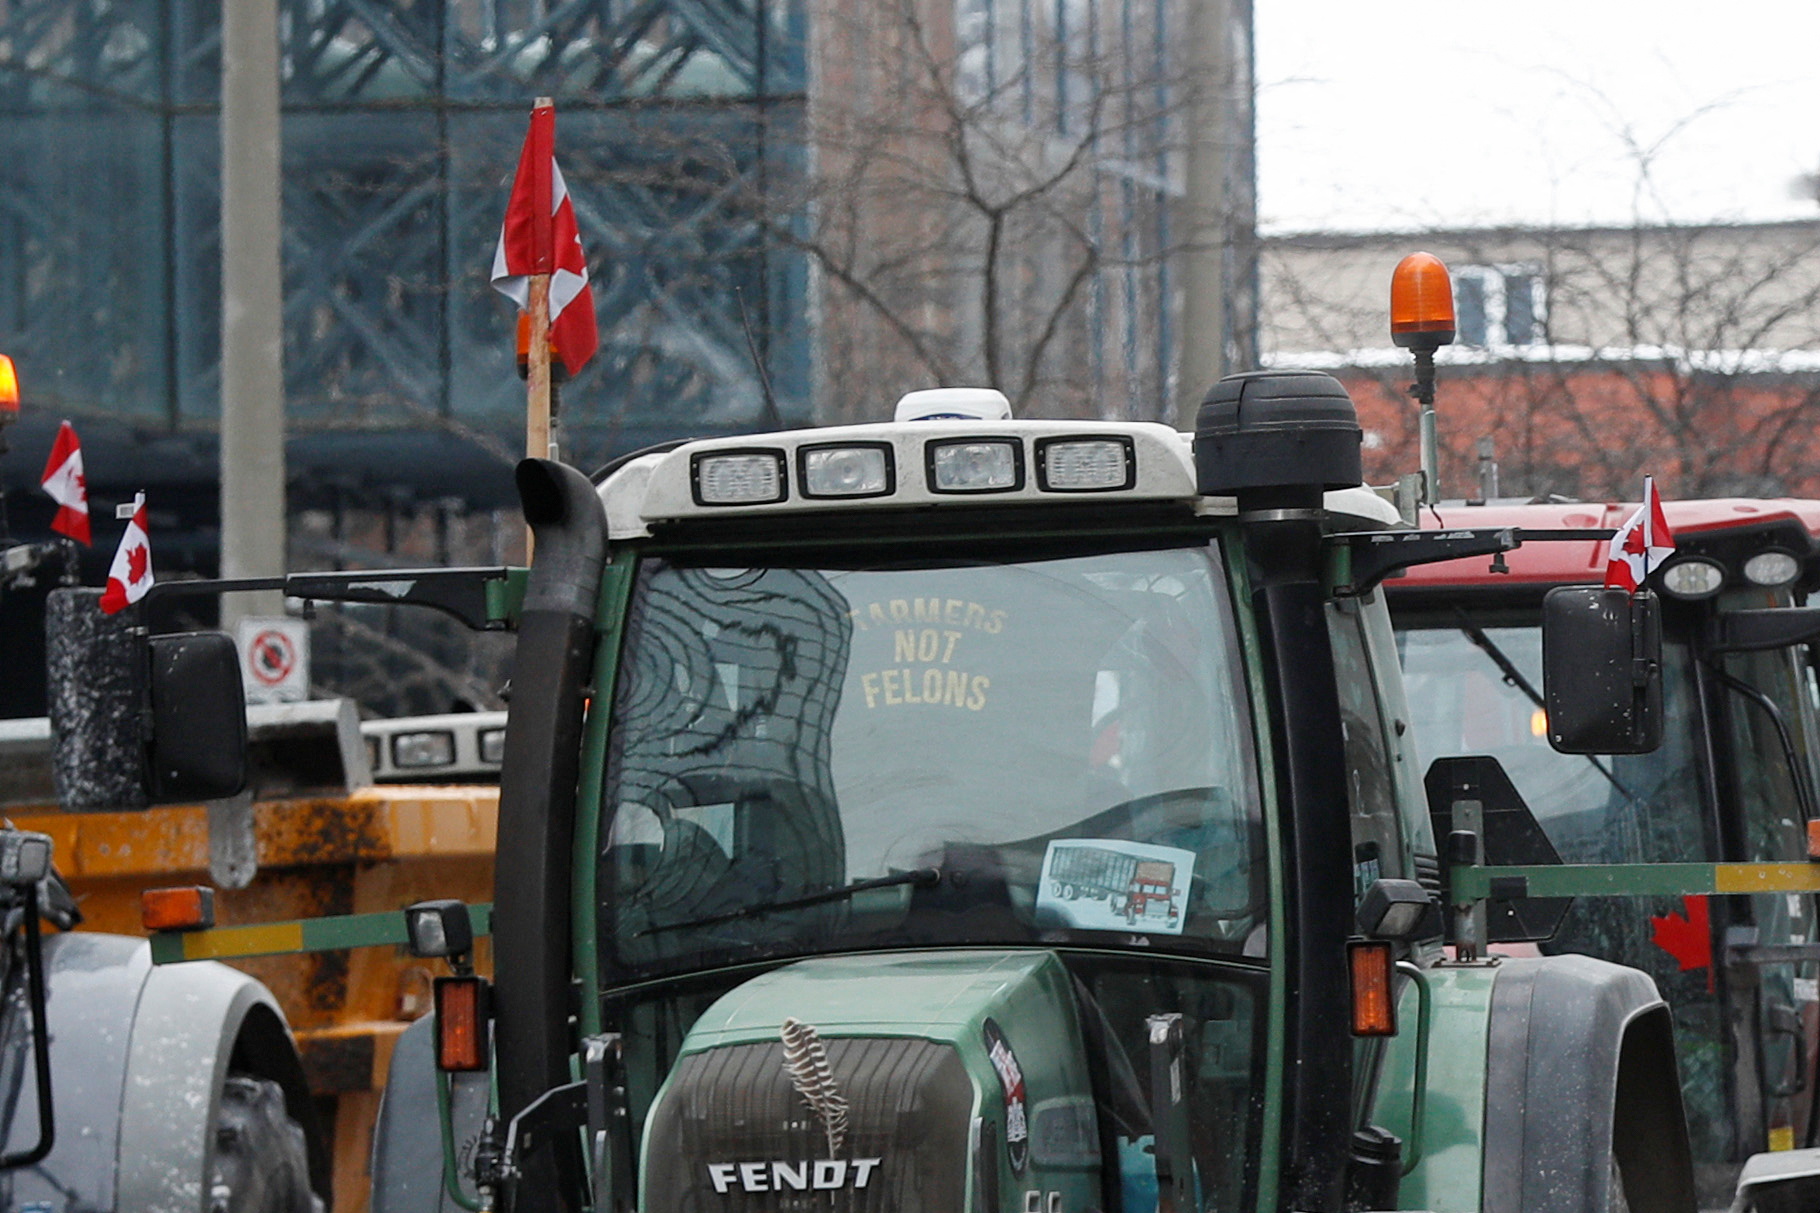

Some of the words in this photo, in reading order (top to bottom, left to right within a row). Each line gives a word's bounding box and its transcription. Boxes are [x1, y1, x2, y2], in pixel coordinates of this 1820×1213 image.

[895, 628, 962, 663] NOT
[861, 668, 990, 711] FELONS
[708, 1157, 881, 1193] FENDT
